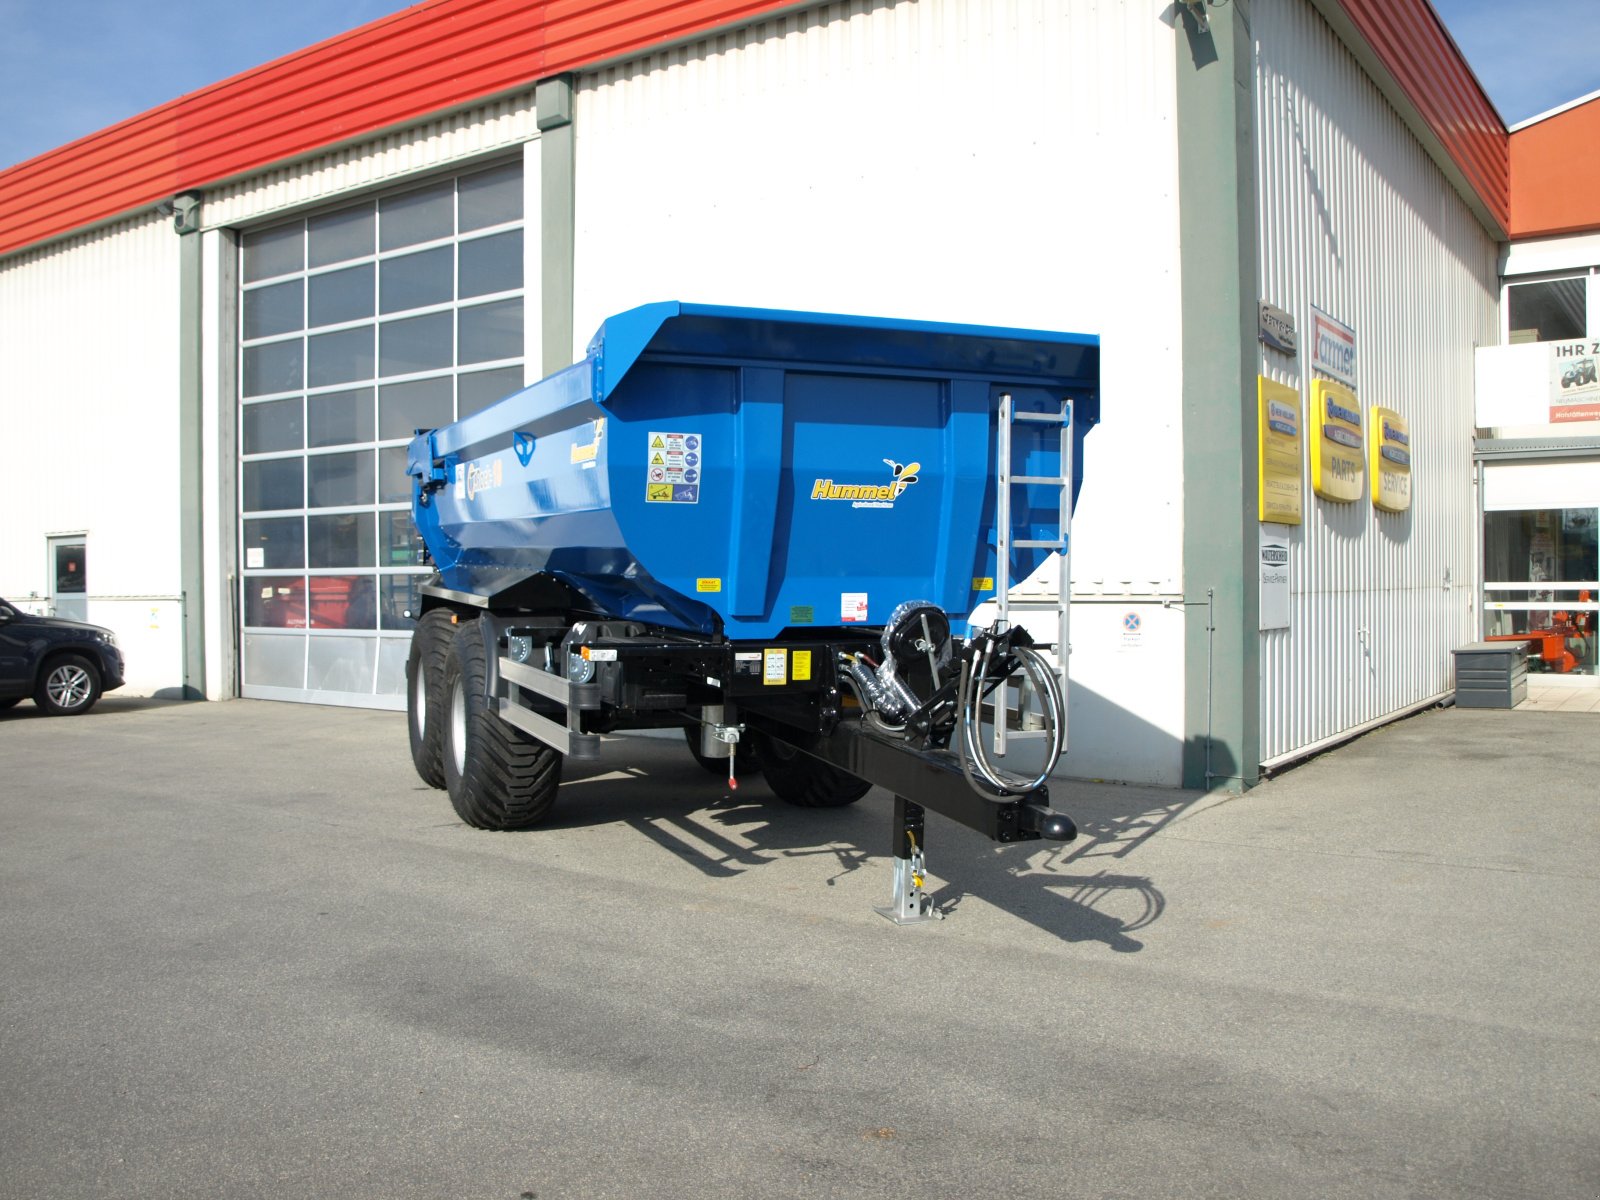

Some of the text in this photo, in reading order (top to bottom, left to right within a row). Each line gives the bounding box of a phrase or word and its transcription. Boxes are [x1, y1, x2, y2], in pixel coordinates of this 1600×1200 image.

[1556, 344, 1585, 357] IHR
[1331, 456, 1355, 483] PARTS
[812, 480, 897, 500] Hummel
[1384, 471, 1407, 496] SERVICE
